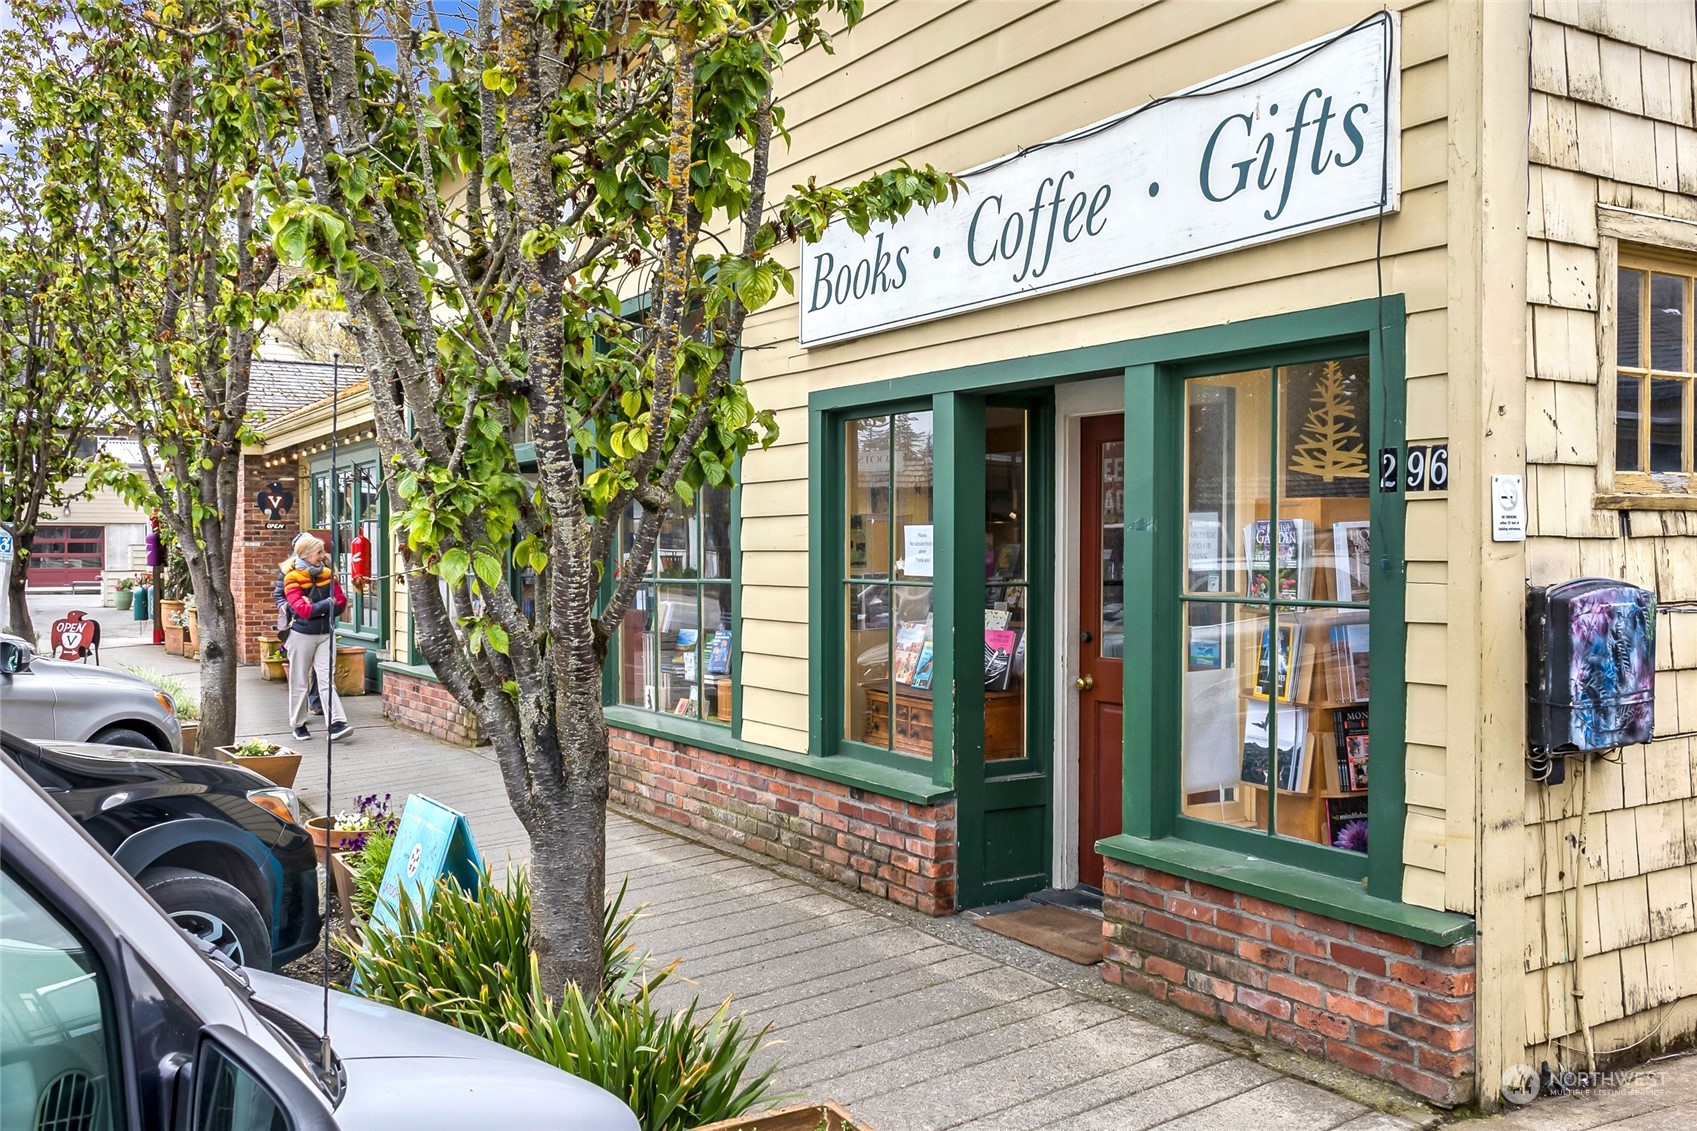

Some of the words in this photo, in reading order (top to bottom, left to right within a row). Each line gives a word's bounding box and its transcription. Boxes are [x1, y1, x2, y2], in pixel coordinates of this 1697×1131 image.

[808, 232, 909, 313] Books
[967, 170, 1111, 282] Coffee
[1200, 88, 1368, 220] Gifts
[1380, 449, 1447, 487] 296
[267, 495, 282, 509] V
[1256, 529, 1297, 544] GADEN
[56, 622, 87, 633] OPEN
[66, 635, 78, 646] V
